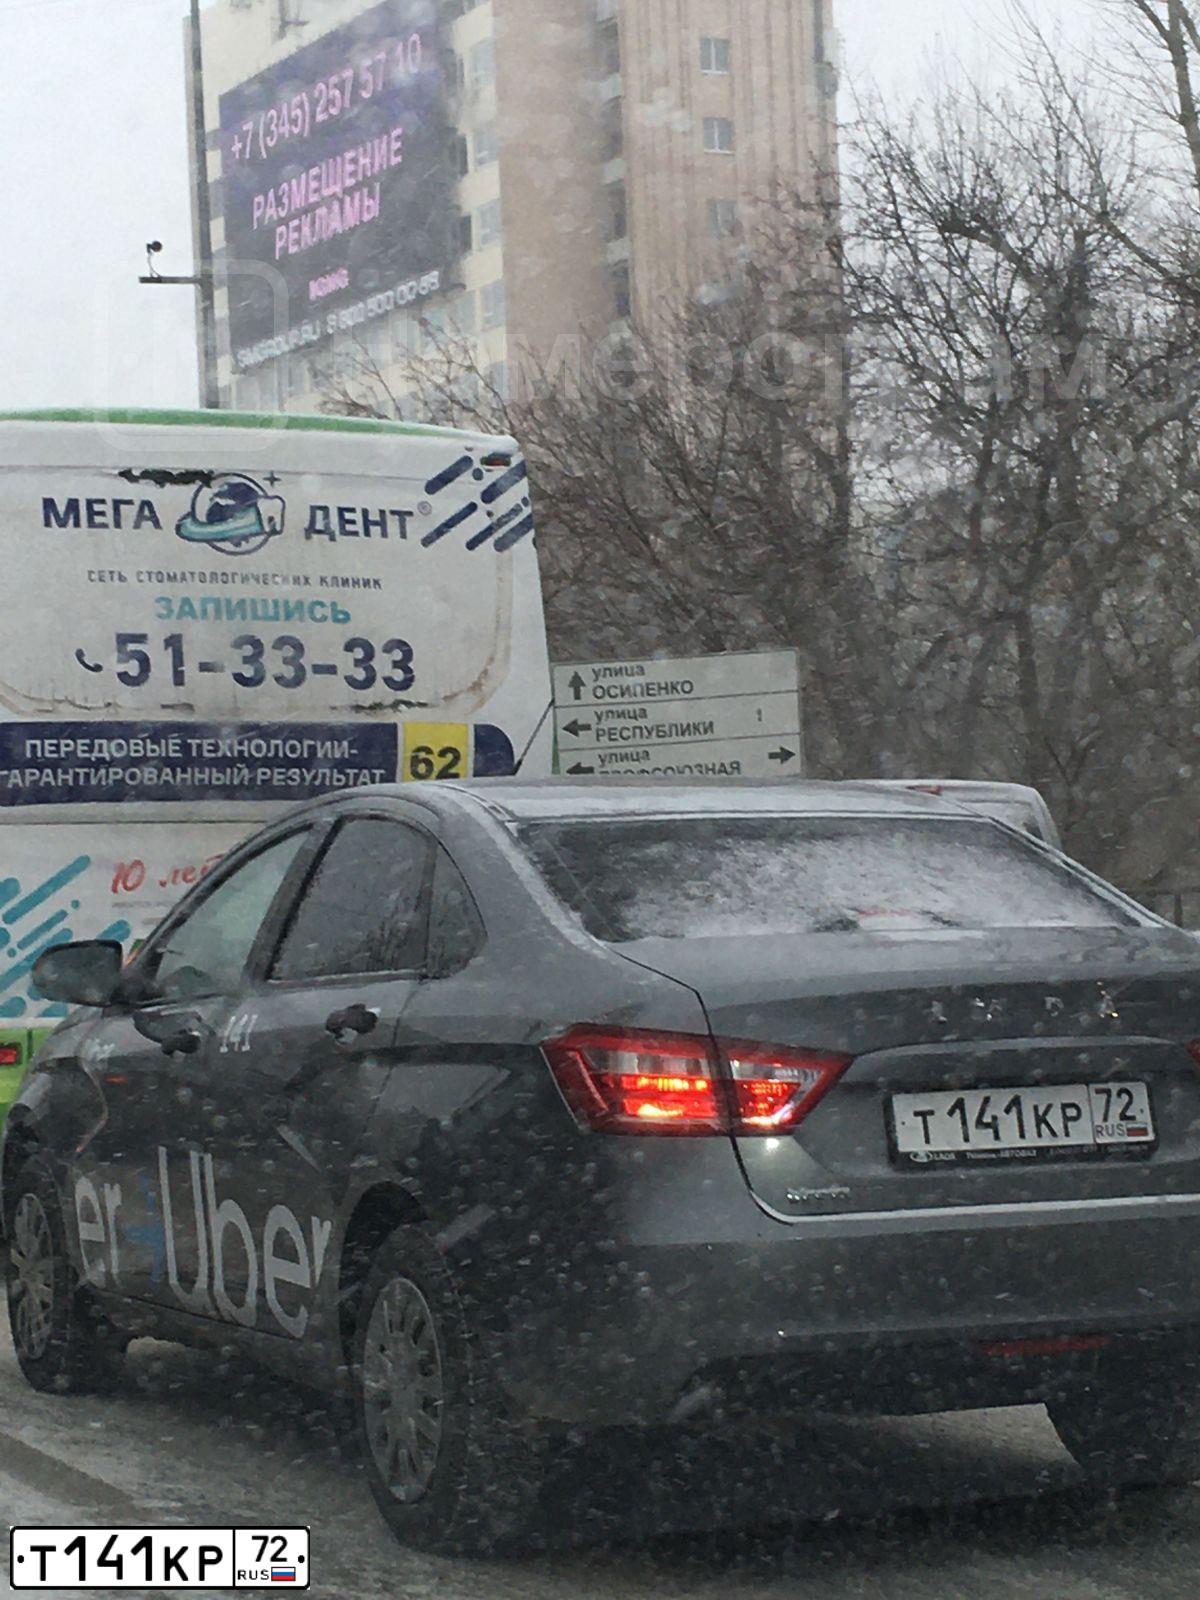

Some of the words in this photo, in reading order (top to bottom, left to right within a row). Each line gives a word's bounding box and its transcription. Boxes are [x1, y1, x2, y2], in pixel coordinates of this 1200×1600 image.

[258, 91, 310, 160] (345)
[315, 68, 354, 123] 257
[252, 127, 403, 231] РАЗМЕЩЕНИЕ
[274, 182, 381, 260] РЕКЛАМЫ
[42, 497, 161, 531] МЕГА
[87, 570, 127, 583] СЕТЬ
[319, 575, 383, 590] КЛИНИК
[154, 596, 352, 624] ЗАПИШИСЬ
[115, 632, 416, 691] 51-33-33
[592, 664, 645, 682] улица
[592, 680, 694, 700] ОСИПЕНКО
[593, 707, 648, 725] улица
[595, 720, 714, 743] РЕСПУБЛИКИ
[25, 739, 183, 761] ПЕРЕДОВЫЕ
[410, 745, 461, 779] 62
[598, 749, 650, 768] улица
[257, 767, 386, 786] РЕЗУЛЬТАТ
[599, 760, 742, 775] СОЮЗНАЯ
[111, 859, 145, 894] 10
[1095, 1087, 1136, 1122] 72
[1095, 1123, 1126, 1139] RUS
[158, 1146, 332, 1339] Uber
